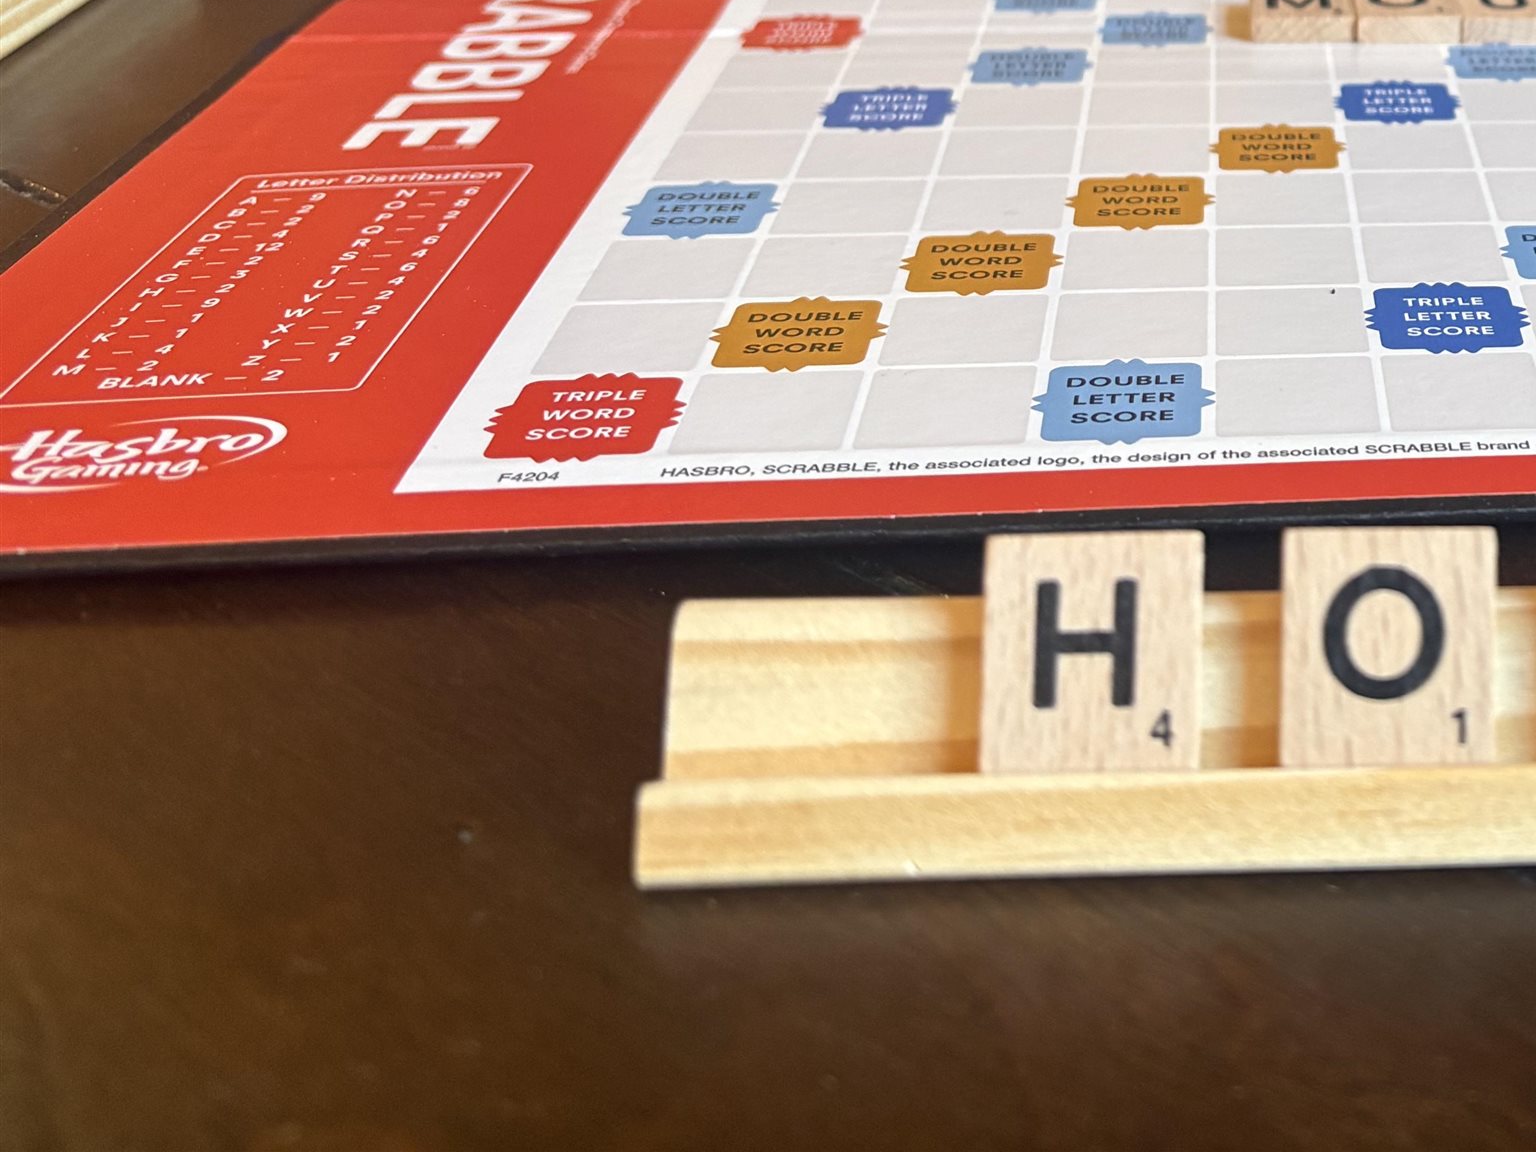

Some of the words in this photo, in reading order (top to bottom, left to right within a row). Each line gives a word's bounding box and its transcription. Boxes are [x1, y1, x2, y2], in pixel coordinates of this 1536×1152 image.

[256, 177, 339, 188] Letter
[344, 170, 503, 184] Distribution
[395, 189, 418, 198] N
[464, 186, 481, 196] 6
[1093, 184, 1189, 193] DOUBLE
[239, 196, 257, 205] A
[309, 193, 326, 201] 9
[658, 191, 760, 201] DOUBLE
[1103, 196, 1178, 205] WORD
[384, 201, 407, 210] O
[454, 198, 471, 208] 8
[658, 203, 746, 213] LETTER
[227, 208, 247, 217] B
[296, 205, 315, 214] 2
[374, 213, 394, 223] P
[443, 210, 461, 220] 2
[1097, 207, 1180, 217] SCORE
[213, 220, 237, 230] C
[283, 217, 303, 226] 2
[651, 215, 740, 226] SCORE
[437, 223, 449, 232] 1
[198, 233, 222, 243] D
[272, 229, 290, 239] 4
[351, 238, 372, 248] R
[422, 235, 441, 245] 6
[186, 246, 207, 256] E
[255, 242, 285, 252] 12
[931, 243, 1036, 253] DOUBLE
[338, 251, 360, 261] S
[411, 249, 429, 259] 4
[940, 256, 1022, 266] WORD
[172, 259, 192, 269] F
[243, 256, 264, 266] 2
[330, 265, 348, 275] T
[400, 262, 418, 272] 6
[155, 273, 179, 283] G
[229, 269, 250, 279] 3
[931, 269, 1023, 280] SCORE
[313, 279, 336, 289] U
[388, 276, 406, 286] 4
[138, 287, 165, 298] H
[214, 284, 236, 293] 2
[303, 293, 323, 303] V
[374, 290, 395, 301] 2
[129, 302, 143, 312] I
[200, 298, 221, 308] 9
[1403, 296, 1483, 307] TRIPLE
[284, 308, 314, 318] W
[362, 305, 382, 315] 2
[748, 311, 863, 323] DOUBLE
[1404, 311, 1491, 322] LETTER
[110, 317, 129, 327] J
[190, 312, 205, 323] 1
[270, 323, 296, 334] X
[354, 320, 368, 330] 1
[756, 326, 844, 338] WORD
[1408, 325, 1494, 337] SCORE
[91, 332, 117, 343] K
[175, 328, 189, 338] 1
[262, 339, 281, 349] Y
[335, 335, 357, 347] 2
[76, 348, 91, 359] L
[154, 344, 175, 354] 4
[743, 342, 843, 354] SCORE
[241, 355, 267, 366] Z
[328, 352, 340, 363] 1
[51, 364, 86, 376] M
[136, 360, 160, 371] 2
[98, 373, 214, 389] BLANK
[261, 370, 284, 381] 2
[1067, 374, 1184, 388] DOUBLE
[553, 389, 646, 402] TRIPLE
[1073, 392, 1175, 406] LETTER
[544, 407, 635, 421] WORD
[1071, 409, 1173, 424] SCORE
[525, 426, 631, 440] SCORE
[11, 428, 265, 464] Hasbro
[660, 465, 755, 477] HASBRO,
[762, 461, 881, 474] SCRABBLE,
[889, 461, 920, 471] the
[924, 456, 1032, 470] associated
[1037, 456, 1085, 467] logo,
[1092, 454, 1122, 464] the
[1127, 452, 1191, 463] design
[1197, 450, 1216, 460] of
[1222, 449, 1252, 459] the
[1257, 445, 1359, 458] associated
[1365, 441, 1472, 454] SCRABBLE
[1476, 440, 1530, 451] brand
[11, 456, 200, 484] Gaming
[497, 471, 560, 483] F4204
[1150, 709, 1174, 747] 4
[1451, 707, 1468, 744] 1
